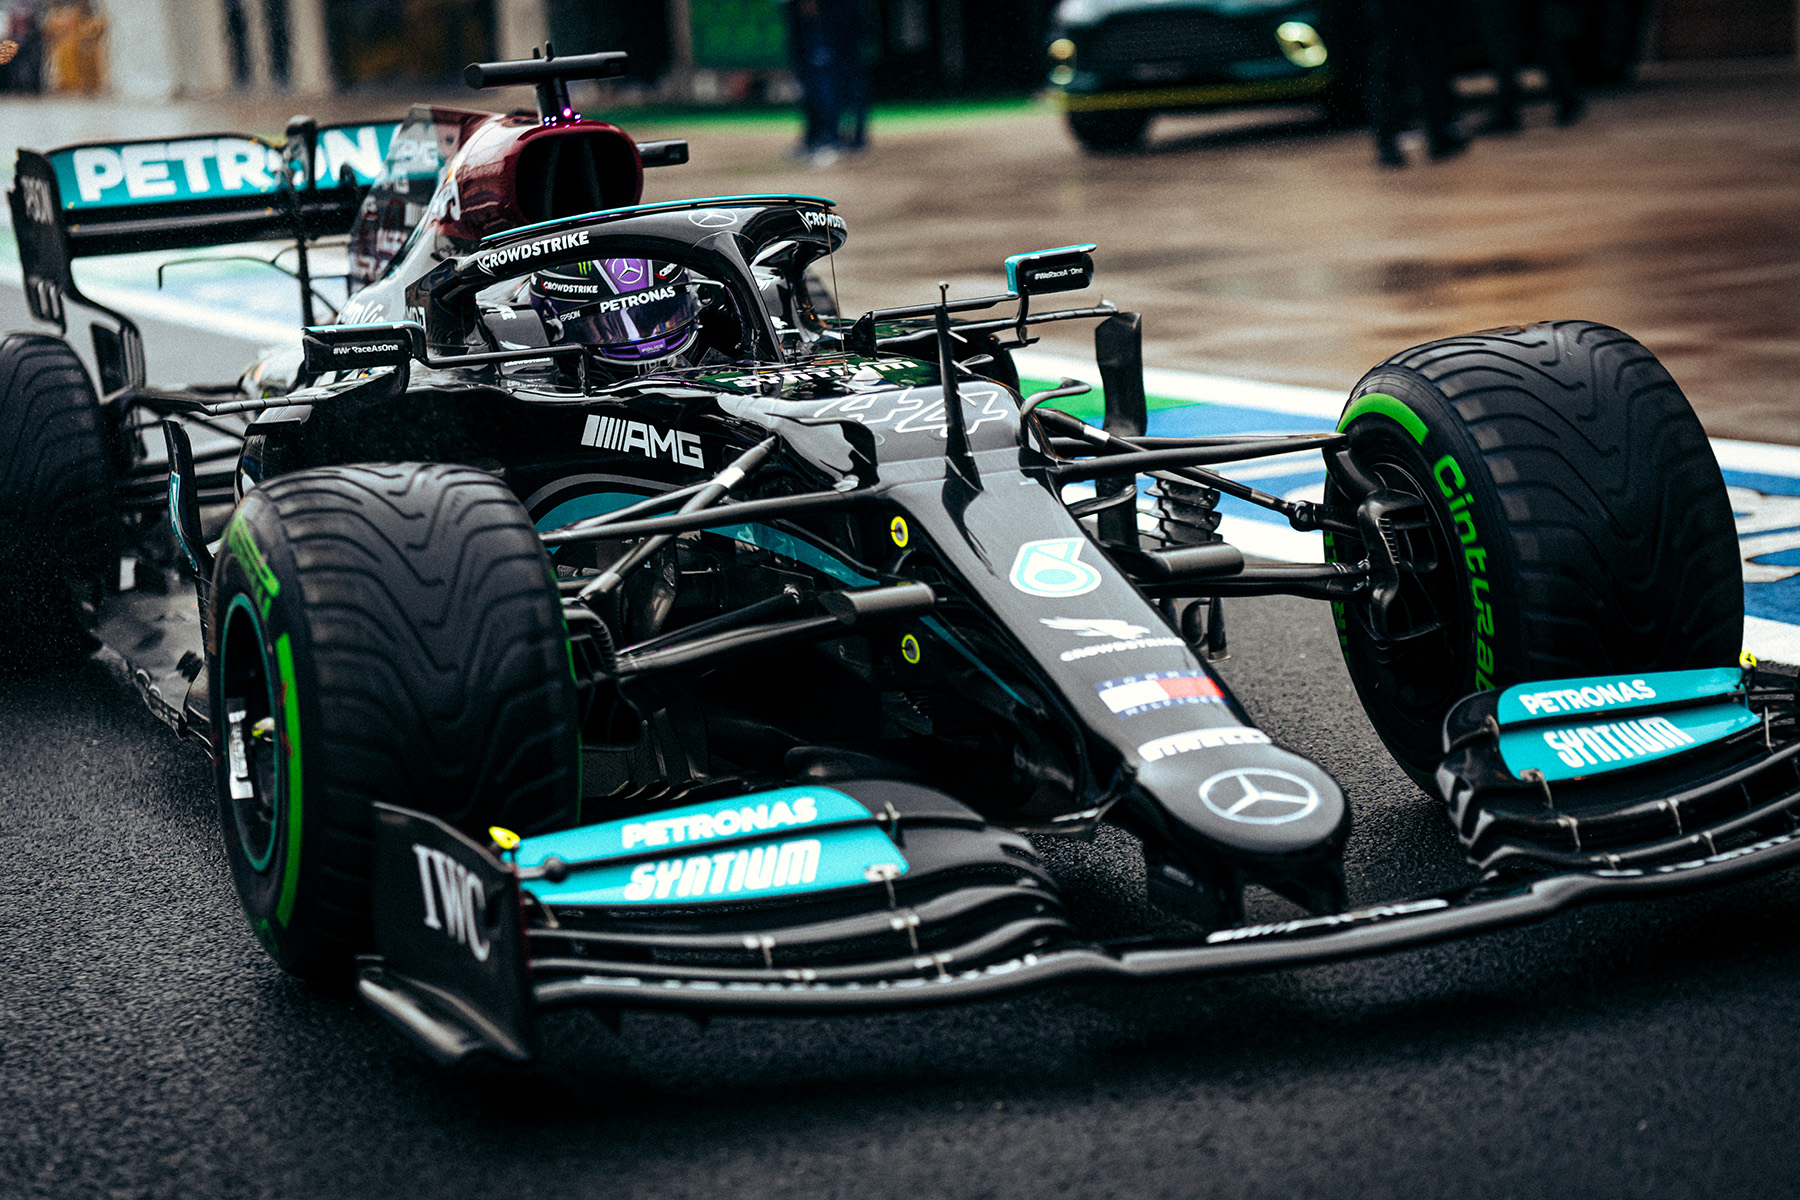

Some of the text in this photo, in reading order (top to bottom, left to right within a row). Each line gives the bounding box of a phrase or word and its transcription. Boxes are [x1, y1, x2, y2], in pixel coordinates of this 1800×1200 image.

[482, 231, 590, 270] CROWDSTRIKE
[543, 281, 598, 294] CROWDSTRIKE
[1034, 267, 1084, 280] #WeRaceAOne
[560, 310, 580, 322] EPSON
[600, 286, 676, 313] PETRONAS
[622, 420, 705, 470] AMG
[1433, 454, 1497, 692] Cinturat
[1519, 679, 1656, 715] PETRONAS
[1543, 716, 1695, 768] SYNTIUM
[621, 797, 818, 848] PETRONAS
[623, 839, 822, 900] SYNTIUM
[411, 843, 490, 962] IWC
